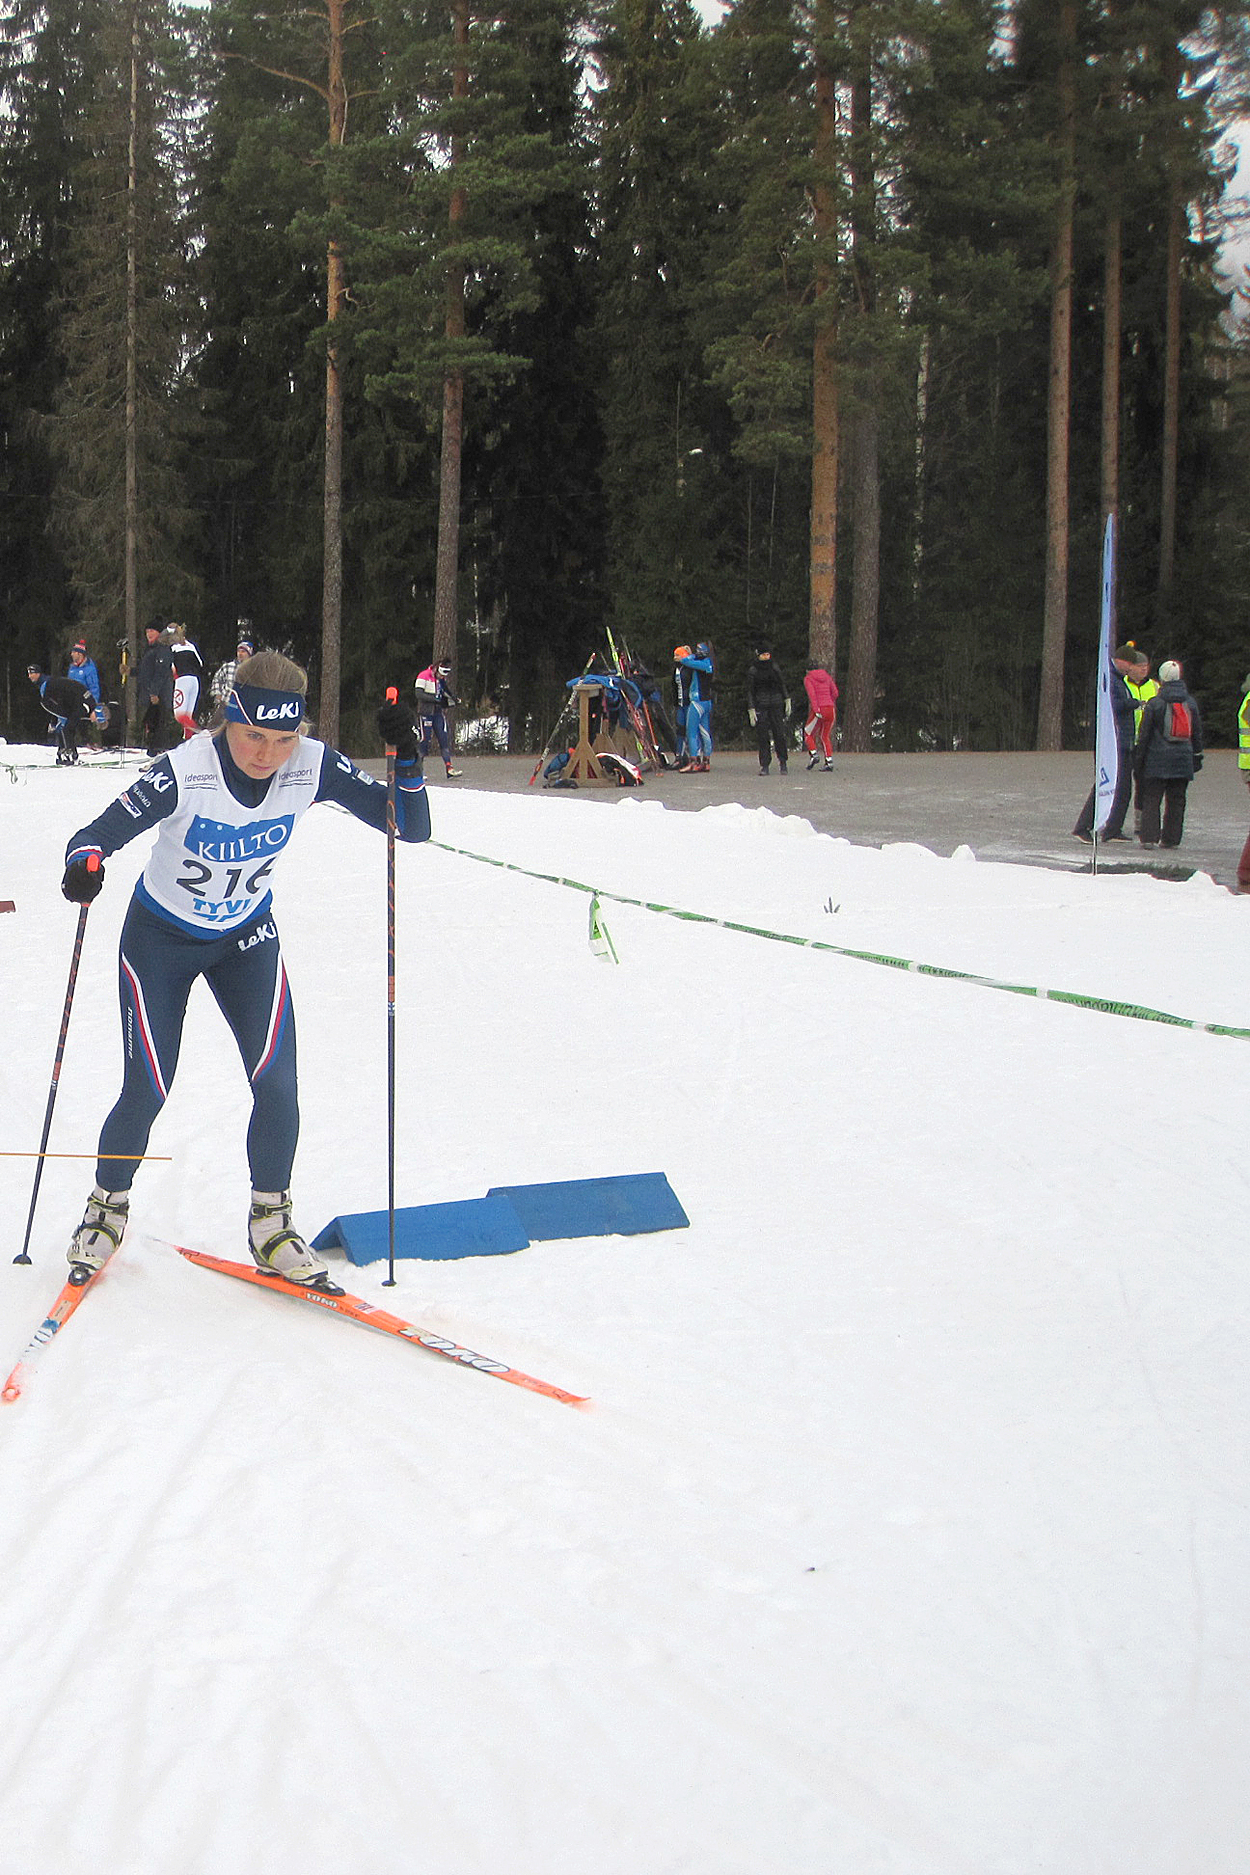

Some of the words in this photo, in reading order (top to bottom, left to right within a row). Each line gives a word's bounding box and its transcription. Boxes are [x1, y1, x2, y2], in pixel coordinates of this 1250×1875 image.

[141, 767, 174, 794] eKi
[198, 824, 288, 861] KIILTO
[176, 856, 276, 898] 216
[193, 898, 252, 914] TYVI
